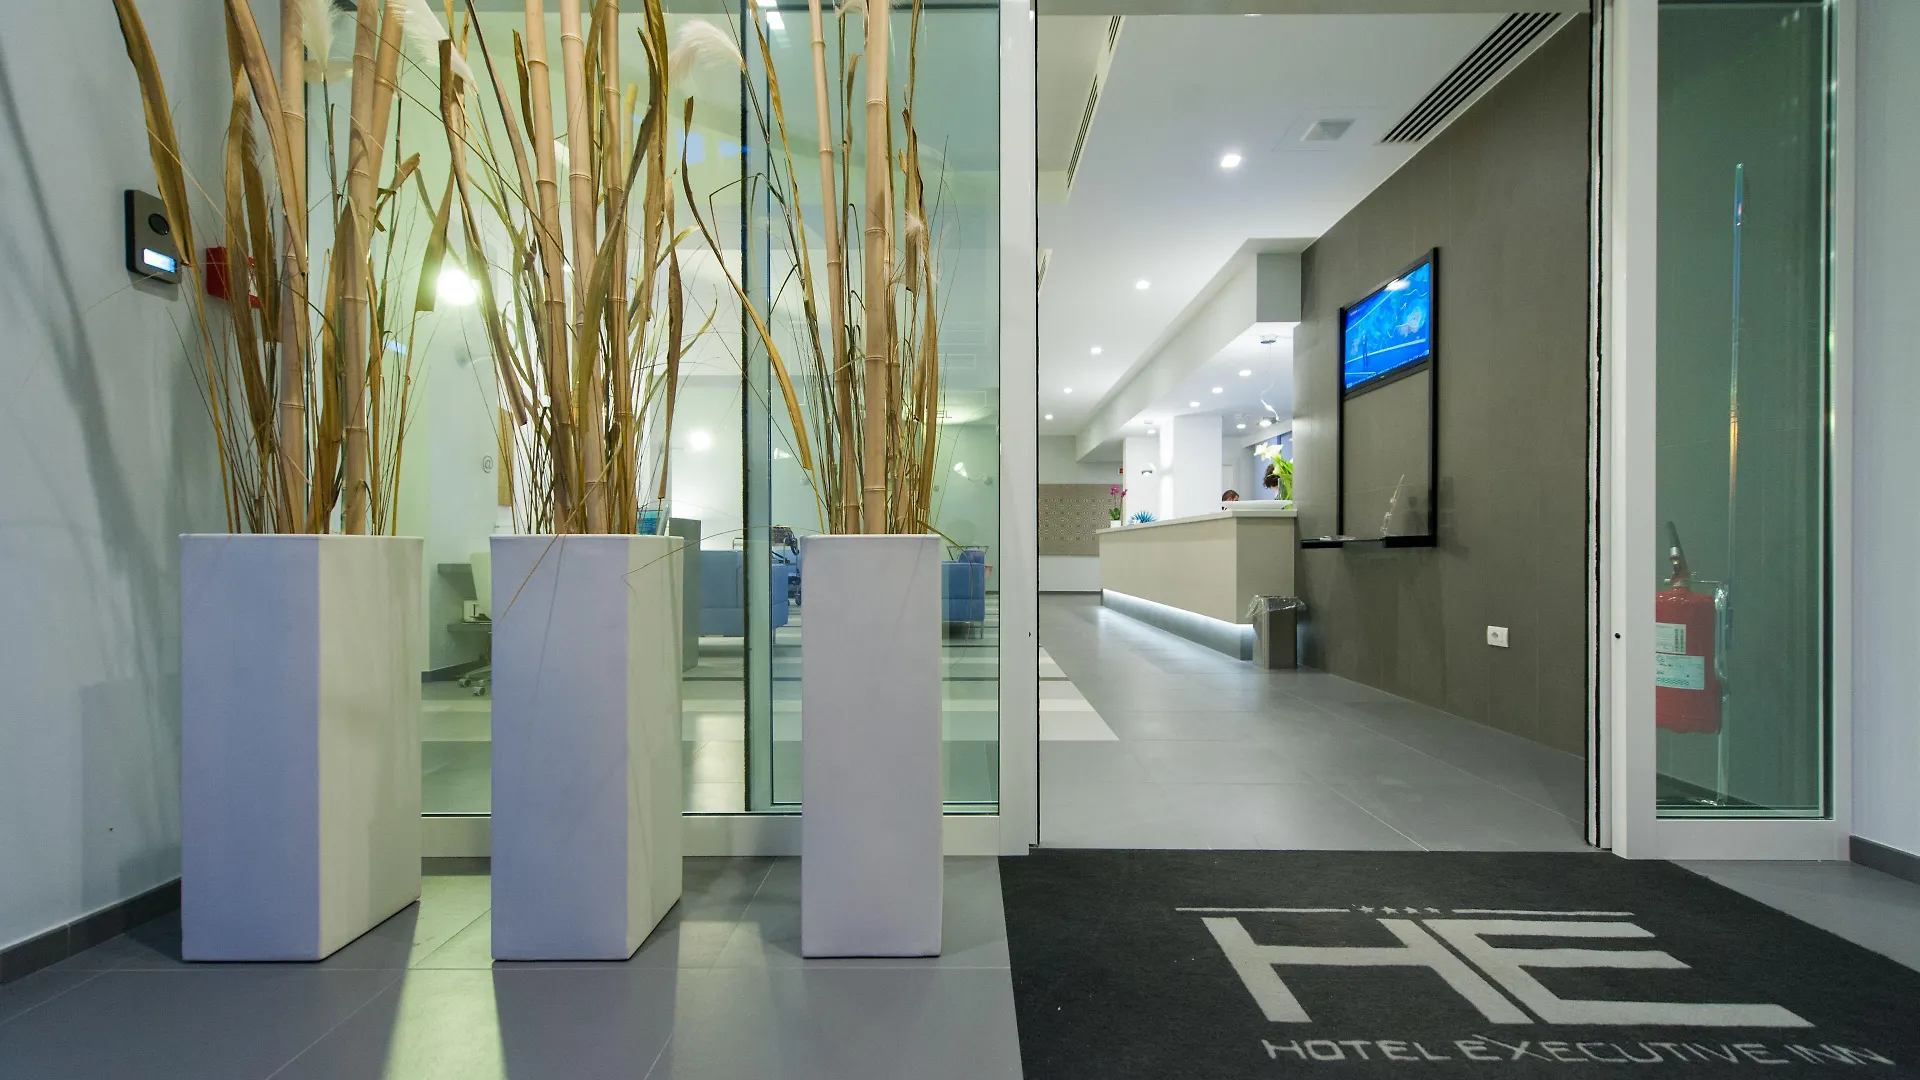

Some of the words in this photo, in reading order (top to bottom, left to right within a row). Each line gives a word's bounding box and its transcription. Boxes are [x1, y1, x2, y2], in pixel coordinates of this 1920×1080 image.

[1261, 1038, 1451, 1061] HOTEL
[1454, 1034, 1790, 1063] EXECUTIVE
[1783, 1044, 1897, 1065] INN
